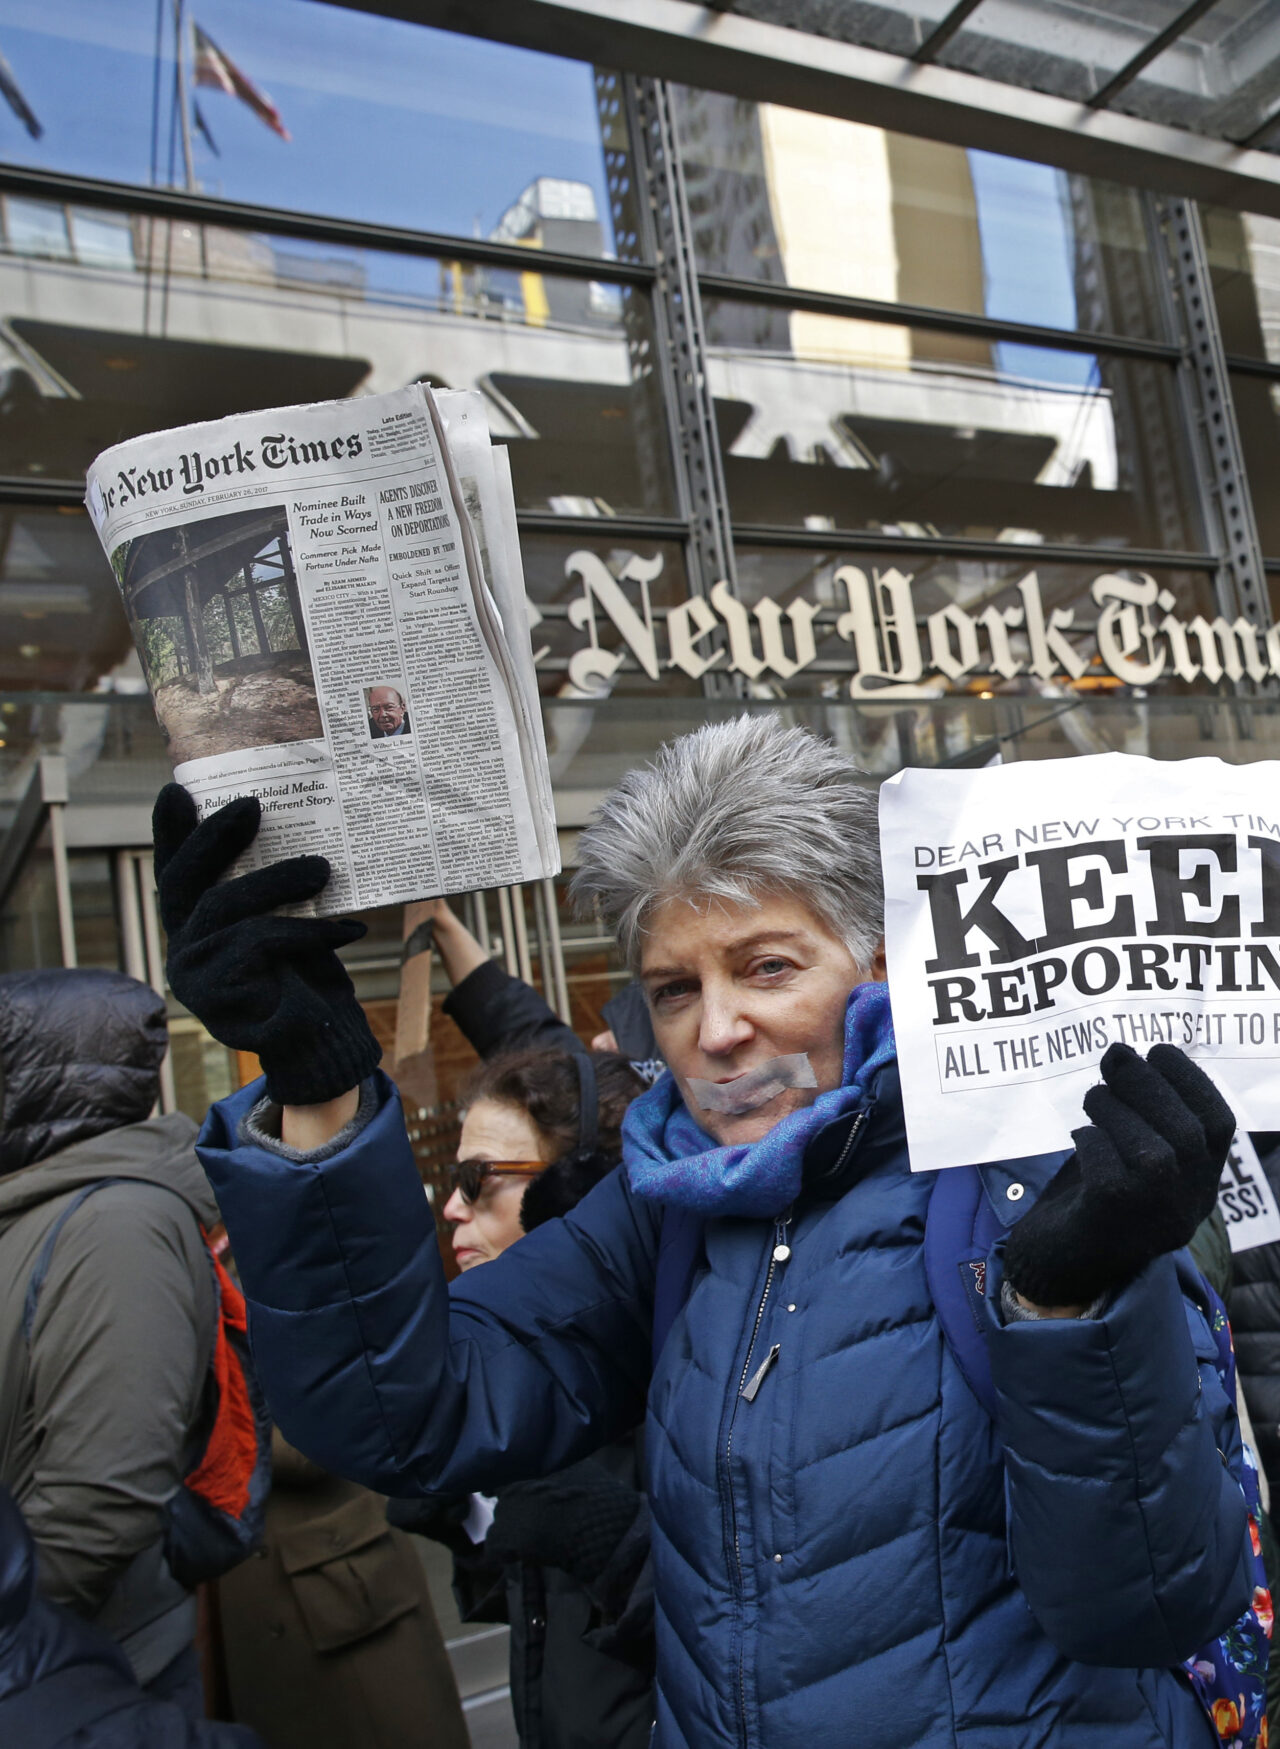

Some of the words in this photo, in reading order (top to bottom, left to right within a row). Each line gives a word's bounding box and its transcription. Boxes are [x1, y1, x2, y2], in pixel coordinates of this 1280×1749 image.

[395, 412, 412, 420] Edition
[118, 466, 174, 507] New
[179, 441, 256, 494] York
[261, 432, 362, 469] Times
[380, 486, 408, 504] AGENTS
[409, 480, 438, 498] DISCOVER
[145, 509, 158, 518] NEW
[160, 505, 179, 516] YORK,
[180, 499, 206, 510] SUNDAY,
[207, 490, 242, 503] FEBRUARY
[293, 500, 338, 513] Nominee
[341, 494, 366, 506] Built
[388, 508, 393, 520] A
[395, 504, 412, 519] NEW
[415, 497, 443, 515] FREEDOM
[300, 513, 328, 526] Trade
[332, 512, 341, 522] in
[345, 509, 372, 522] Ways
[391, 524, 403, 537] ON
[404, 514, 450, 536] DEPORTATIONS
[310, 527, 333, 539] Now
[337, 521, 378, 536] Scorned
[300, 550, 338, 561] Commerce
[342, 546, 358, 555] Pick
[361, 544, 381, 553] Made
[389, 546, 431, 562] EMBOLDENED
[433, 545, 441, 554] BY
[305, 561, 333, 571] Fortune
[335, 557, 358, 567] Under
[359, 556, 379, 564] Nafta
[392, 572, 412, 580] Quick
[416, 568, 431, 576] Shift
[401, 580, 426, 589] Expand
[427, 586, 459, 595] Roundups
[565, 550, 823, 692] New
[834, 564, 1089, 699] York
[205, 794, 231, 809] Ruled
[250, 784, 288, 798] Tabloid
[292, 781, 328, 794] Media.
[260, 799, 304, 813] Different
[306, 796, 335, 806] Story.
[913, 833, 1004, 869] DEAR
[1016, 818, 1101, 845] NEW
[1113, 815, 1213, 833] YORK
[944, 1044, 990, 1080] ALL
[993, 1034, 1042, 1072] THE
[1046, 1019, 1109, 1064] NEWS
[1234, 1013, 1266, 1045] TO
[1222, 1184, 1268, 1225] SS!
